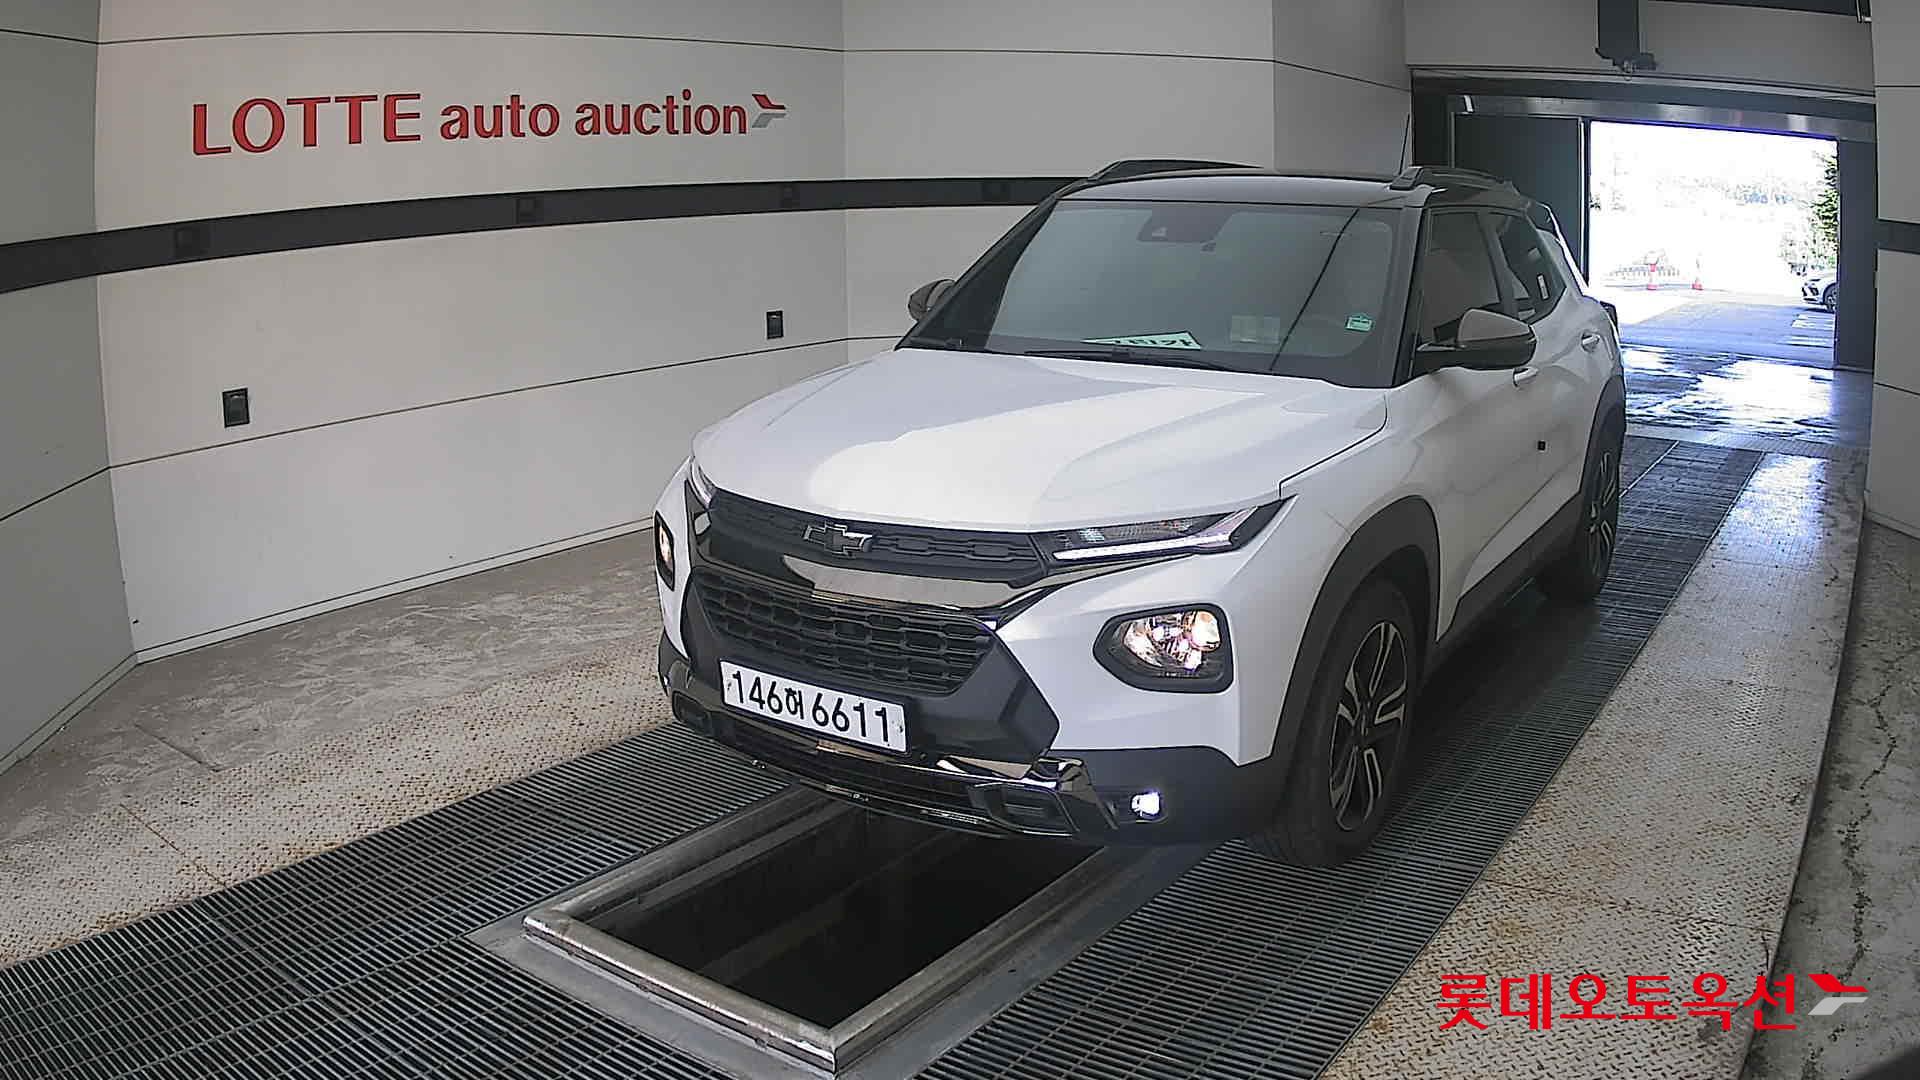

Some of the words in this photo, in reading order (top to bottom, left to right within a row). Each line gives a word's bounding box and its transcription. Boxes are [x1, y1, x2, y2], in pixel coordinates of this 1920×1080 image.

[192, 93, 421, 155] LOTTE
[440, 95, 560, 140] auto
[575, 89, 747, 136] auction
